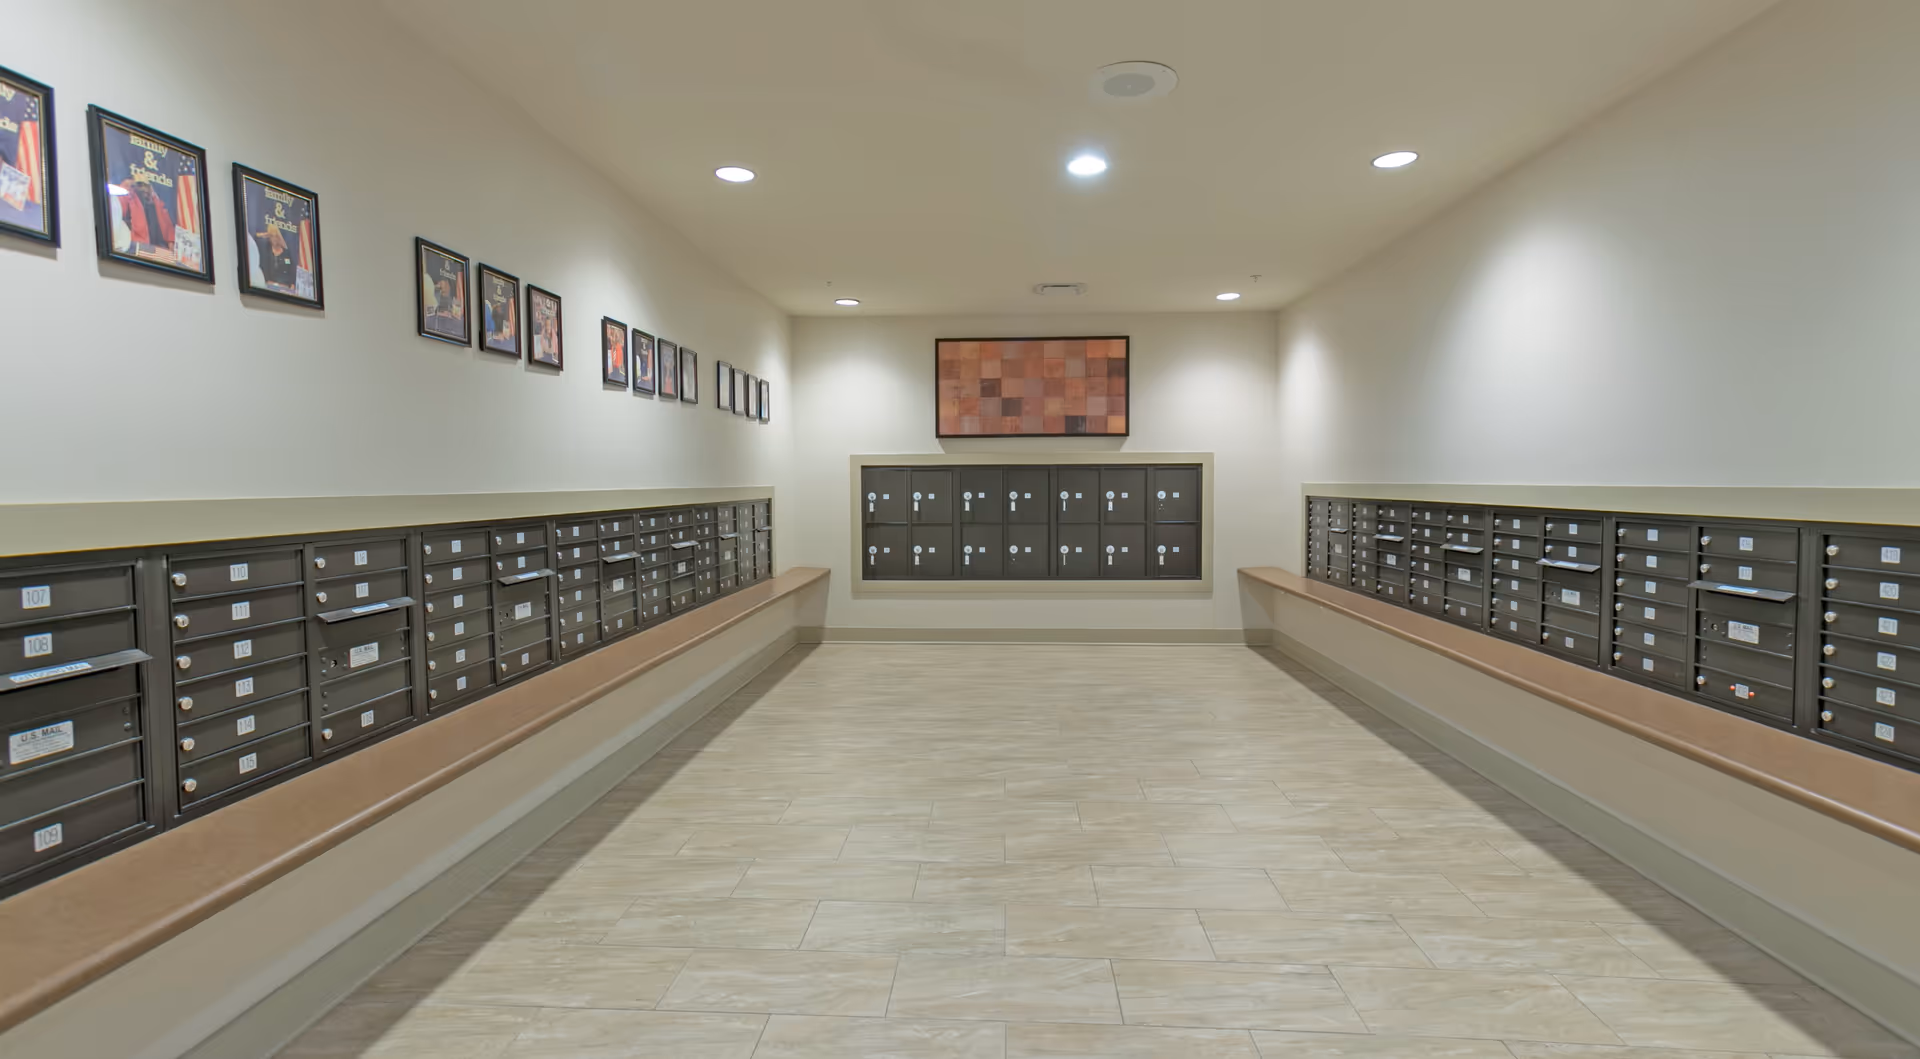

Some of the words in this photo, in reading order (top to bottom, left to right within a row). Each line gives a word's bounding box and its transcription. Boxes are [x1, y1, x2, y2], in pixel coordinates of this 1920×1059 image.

[144, 151, 158, 171] &
[264, 187, 294, 207] family
[275, 202, 286, 219] &
[232, 566, 246, 578] 110
[27, 589, 47, 606] 107
[28, 637, 49, 655] 108
[21, 731, 39, 742] U.S.
[41, 727, 62, 737] MAIL
[38, 828, 59, 847] 109
